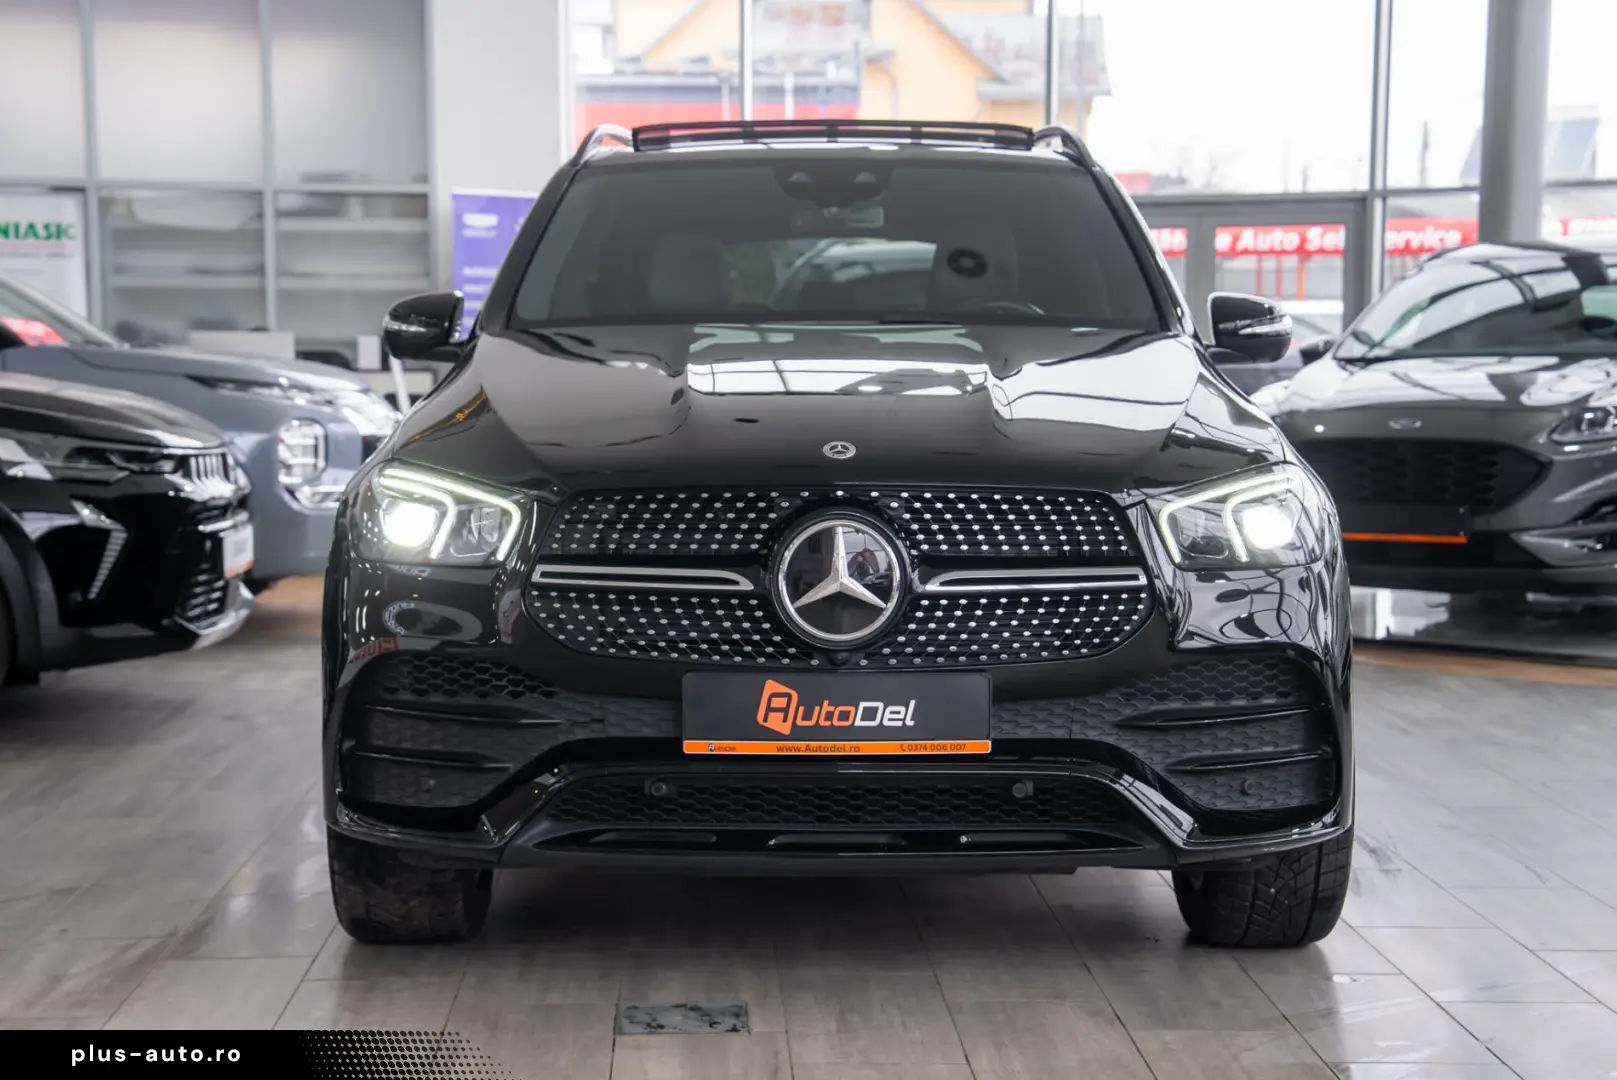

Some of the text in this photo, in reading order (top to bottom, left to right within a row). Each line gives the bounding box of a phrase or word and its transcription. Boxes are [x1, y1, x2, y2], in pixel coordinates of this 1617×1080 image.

[1236, 226, 1300, 252] Auto
[1304, 225, 1346, 251] Sel
[1384, 226, 1462, 250] ervice
[758, 686, 916, 731] AutoDel
[776, 743, 861, 753] www.Autodel.ro
[907, 742, 966, 752] 0374 006 007
